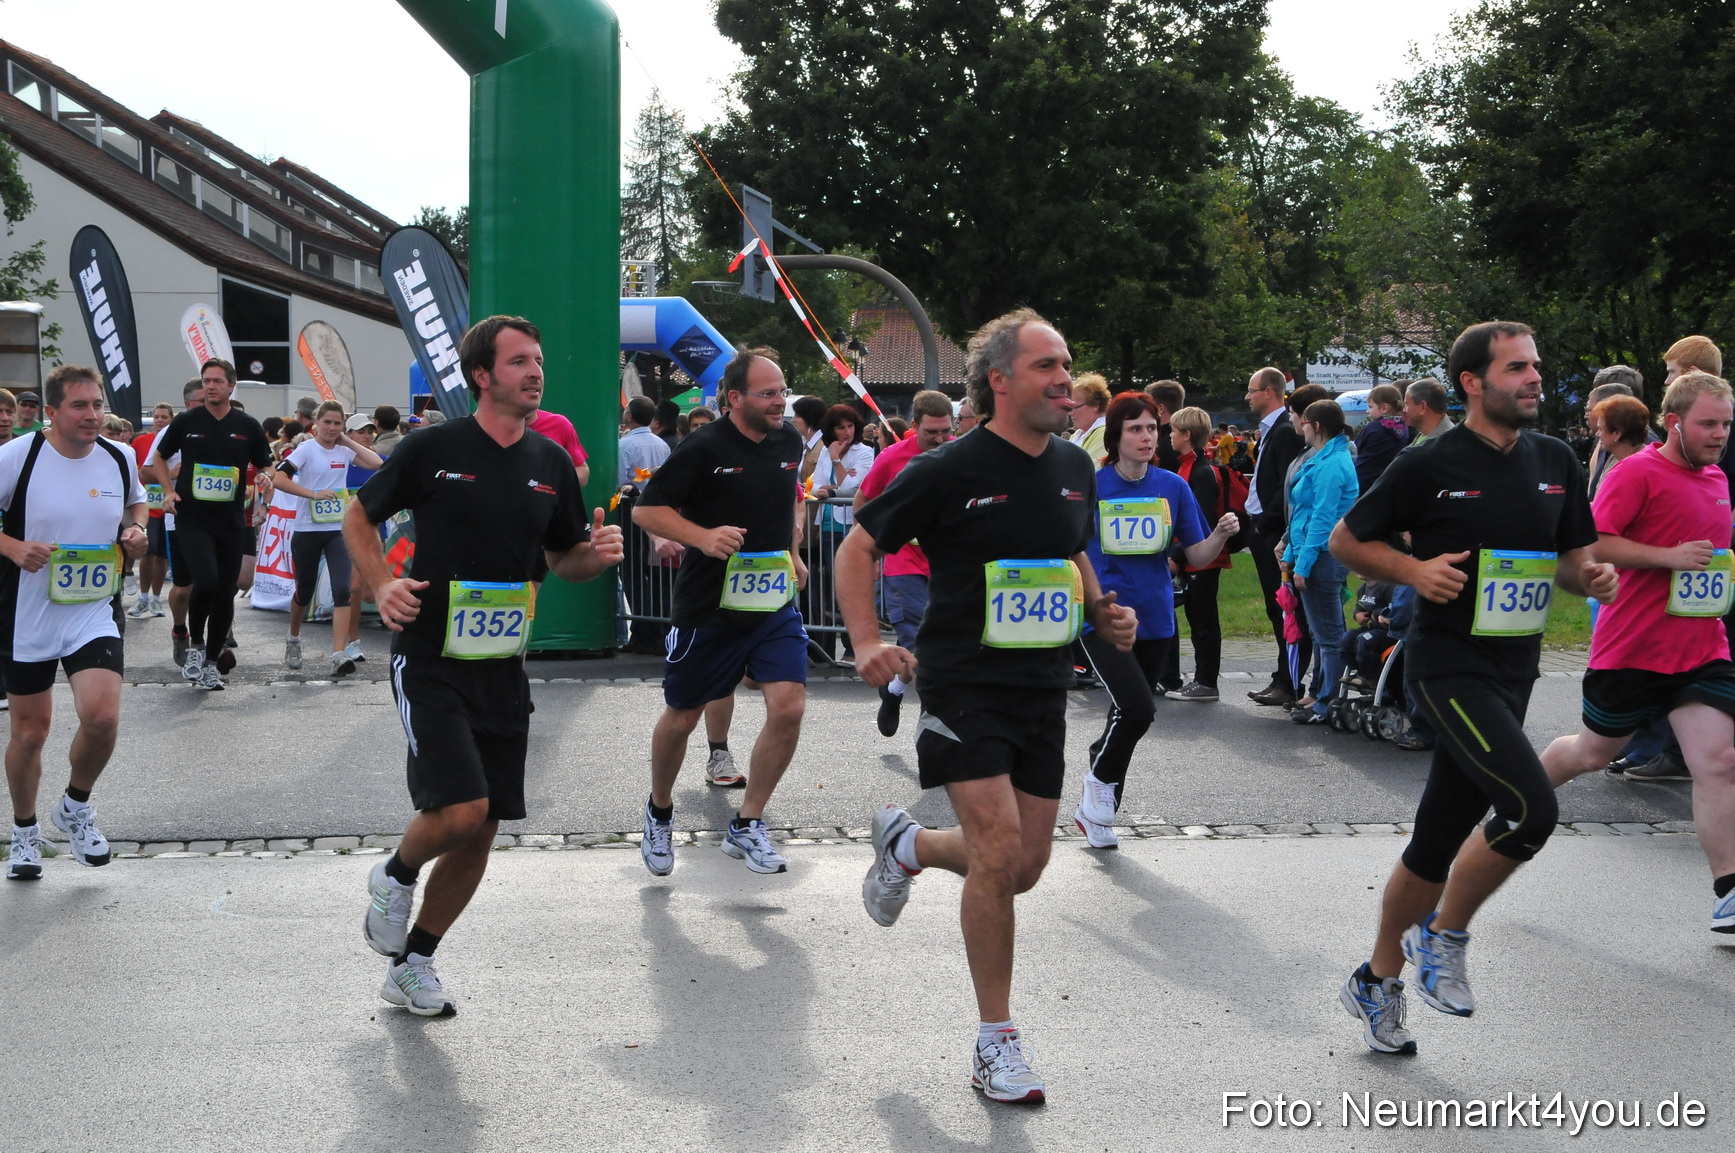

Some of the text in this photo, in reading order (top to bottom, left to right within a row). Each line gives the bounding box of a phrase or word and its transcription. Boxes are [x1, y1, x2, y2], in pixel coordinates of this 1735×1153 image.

[195, 476, 232, 492] 1349
[315, 500, 342, 515] 633
[1109, 516, 1156, 540] 170
[58, 564, 107, 589] 316
[729, 572, 787, 595] 1354
[1678, 571, 1724, 599] 336
[62, 587, 91, 596] Christoph
[1483, 581, 1551, 613] 1350
[1682, 599, 1709, 608] Benjamin
[991, 591, 1068, 623] 1348
[453, 609, 523, 638] 1352
